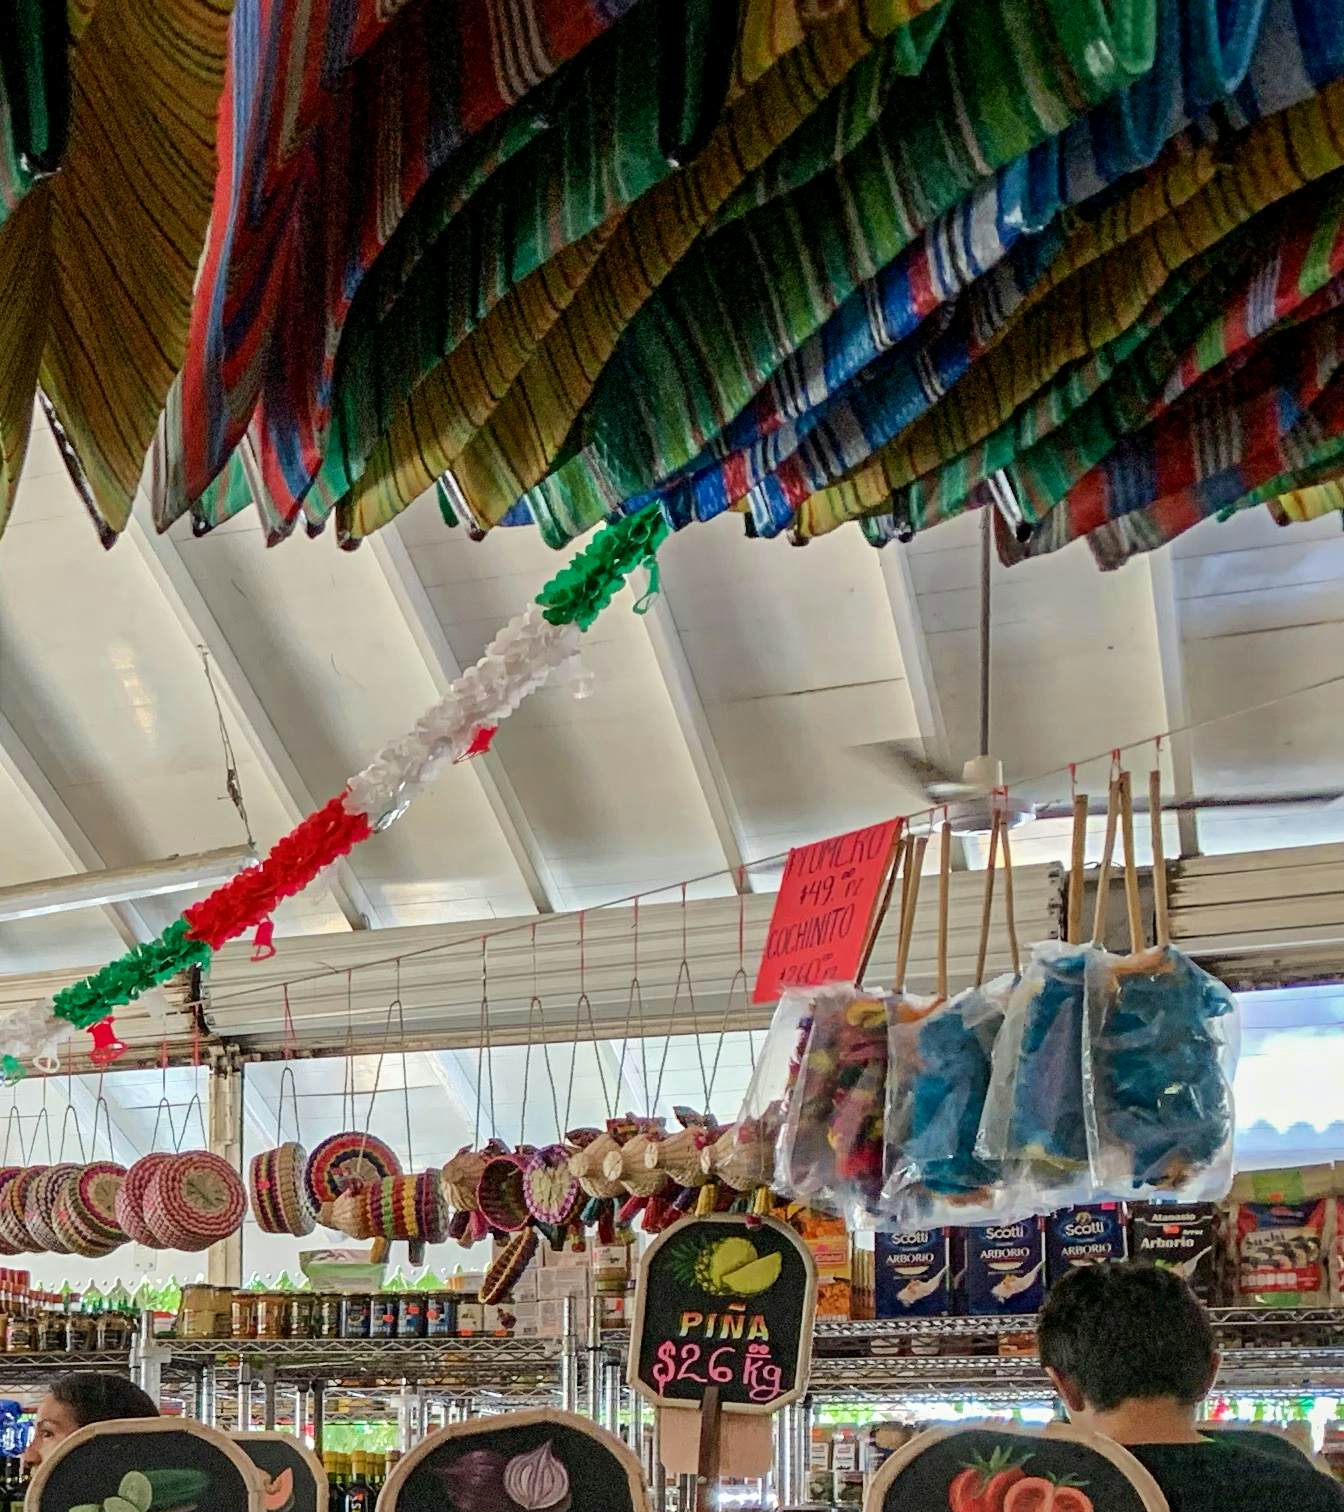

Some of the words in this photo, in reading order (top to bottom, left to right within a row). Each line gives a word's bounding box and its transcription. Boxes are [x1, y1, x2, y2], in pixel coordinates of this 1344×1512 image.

[767, 904, 855, 960] COCHINITO
[1061, 1242, 1112, 1257] ARBORIO
[1140, 1236, 1195, 1250] Arborio
[885, 1251, 935, 1265] ARBORIO
[979, 1245, 1031, 1260] ARBORIO
[678, 1302, 770, 1341] PIÑA
